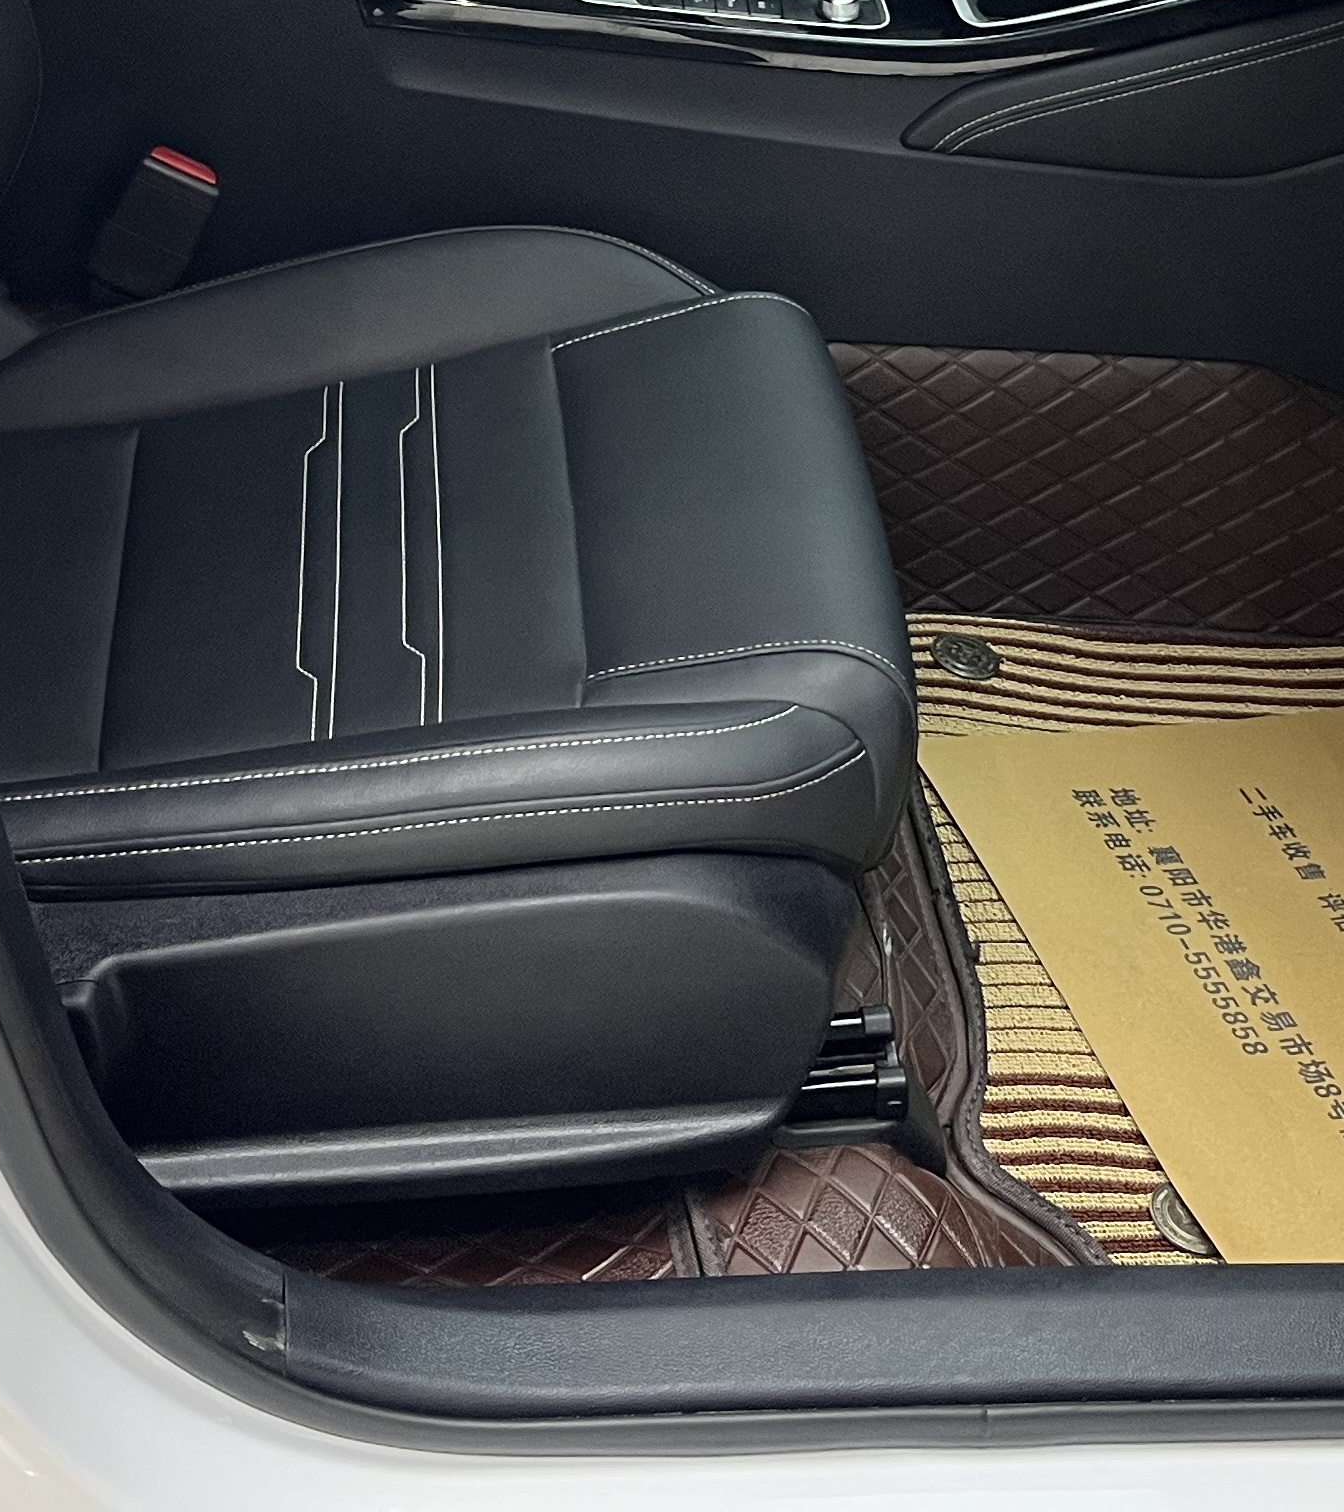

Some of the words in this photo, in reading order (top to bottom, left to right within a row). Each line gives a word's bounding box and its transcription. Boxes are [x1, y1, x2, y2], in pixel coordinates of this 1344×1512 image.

[1238, 787, 1327, 880] 二手车收售
